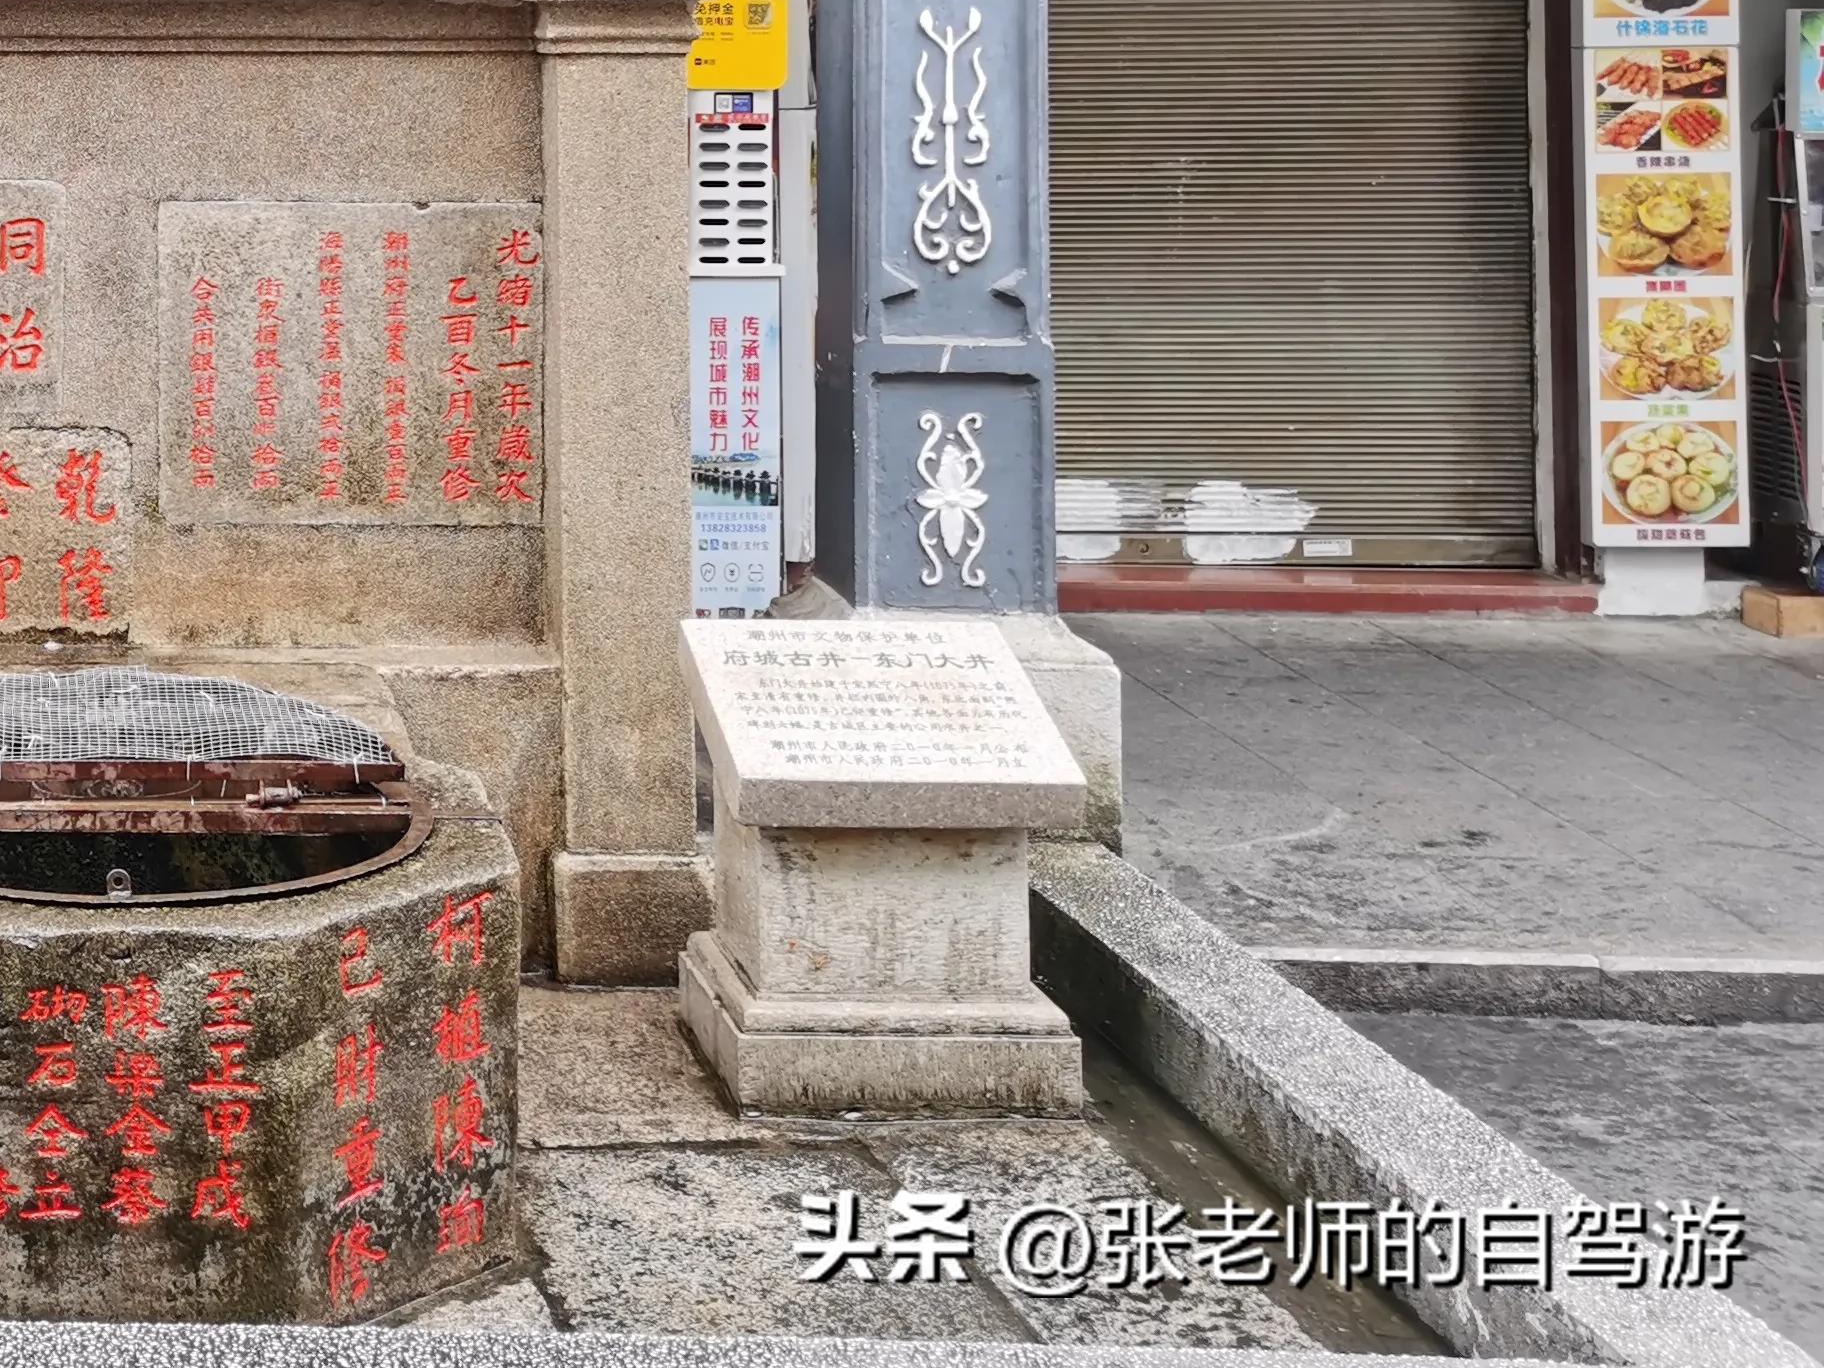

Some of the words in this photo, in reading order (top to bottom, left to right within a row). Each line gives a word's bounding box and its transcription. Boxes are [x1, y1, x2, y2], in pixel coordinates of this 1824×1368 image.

[709, 317, 727, 452] 展现城市魅力
[741, 316, 760, 452] 传承潮州文化
